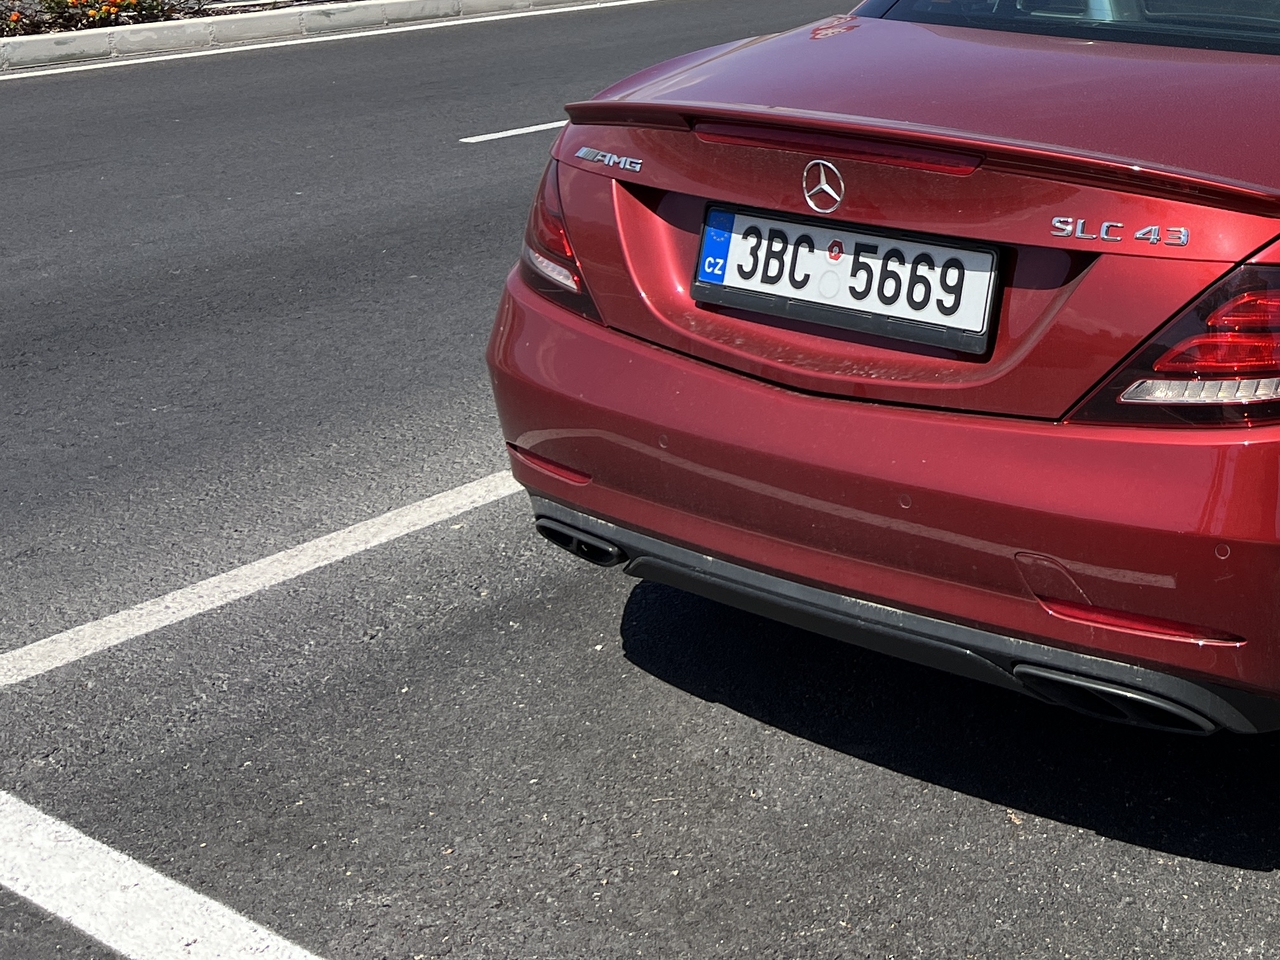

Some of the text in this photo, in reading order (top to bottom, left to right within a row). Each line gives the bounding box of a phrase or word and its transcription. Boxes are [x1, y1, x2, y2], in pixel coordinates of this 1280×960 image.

[594, 151, 643, 172] AMG
[1050, 216, 1190, 246] SLC 43
[703, 256, 724, 276] CZ
[736, 225, 966, 316] 3BC 5669
